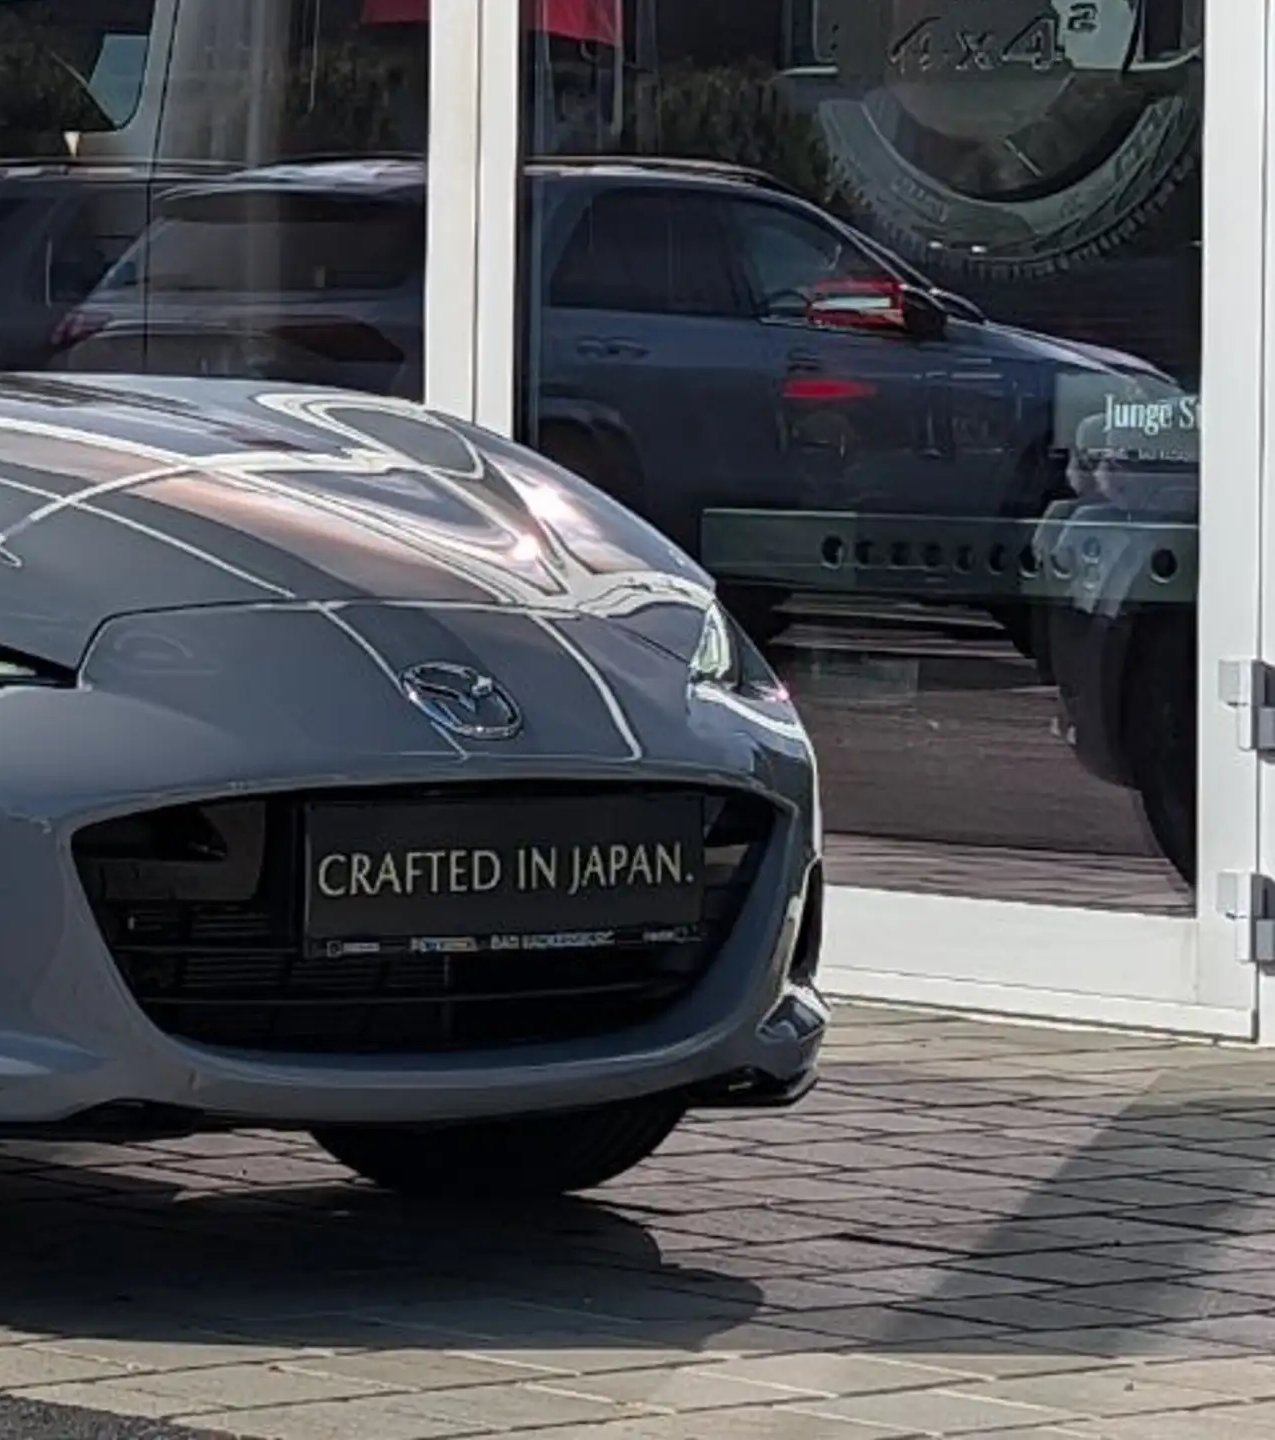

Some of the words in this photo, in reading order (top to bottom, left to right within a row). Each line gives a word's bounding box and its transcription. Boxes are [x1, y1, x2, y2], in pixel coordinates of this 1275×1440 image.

[1101, 393, 1172, 436] Junge
[1179, 396, 1201, 430] S
[318, 849, 501, 896] CRAFTED
[518, 845, 557, 891] IN
[567, 841, 695, 895] JAPAN.
